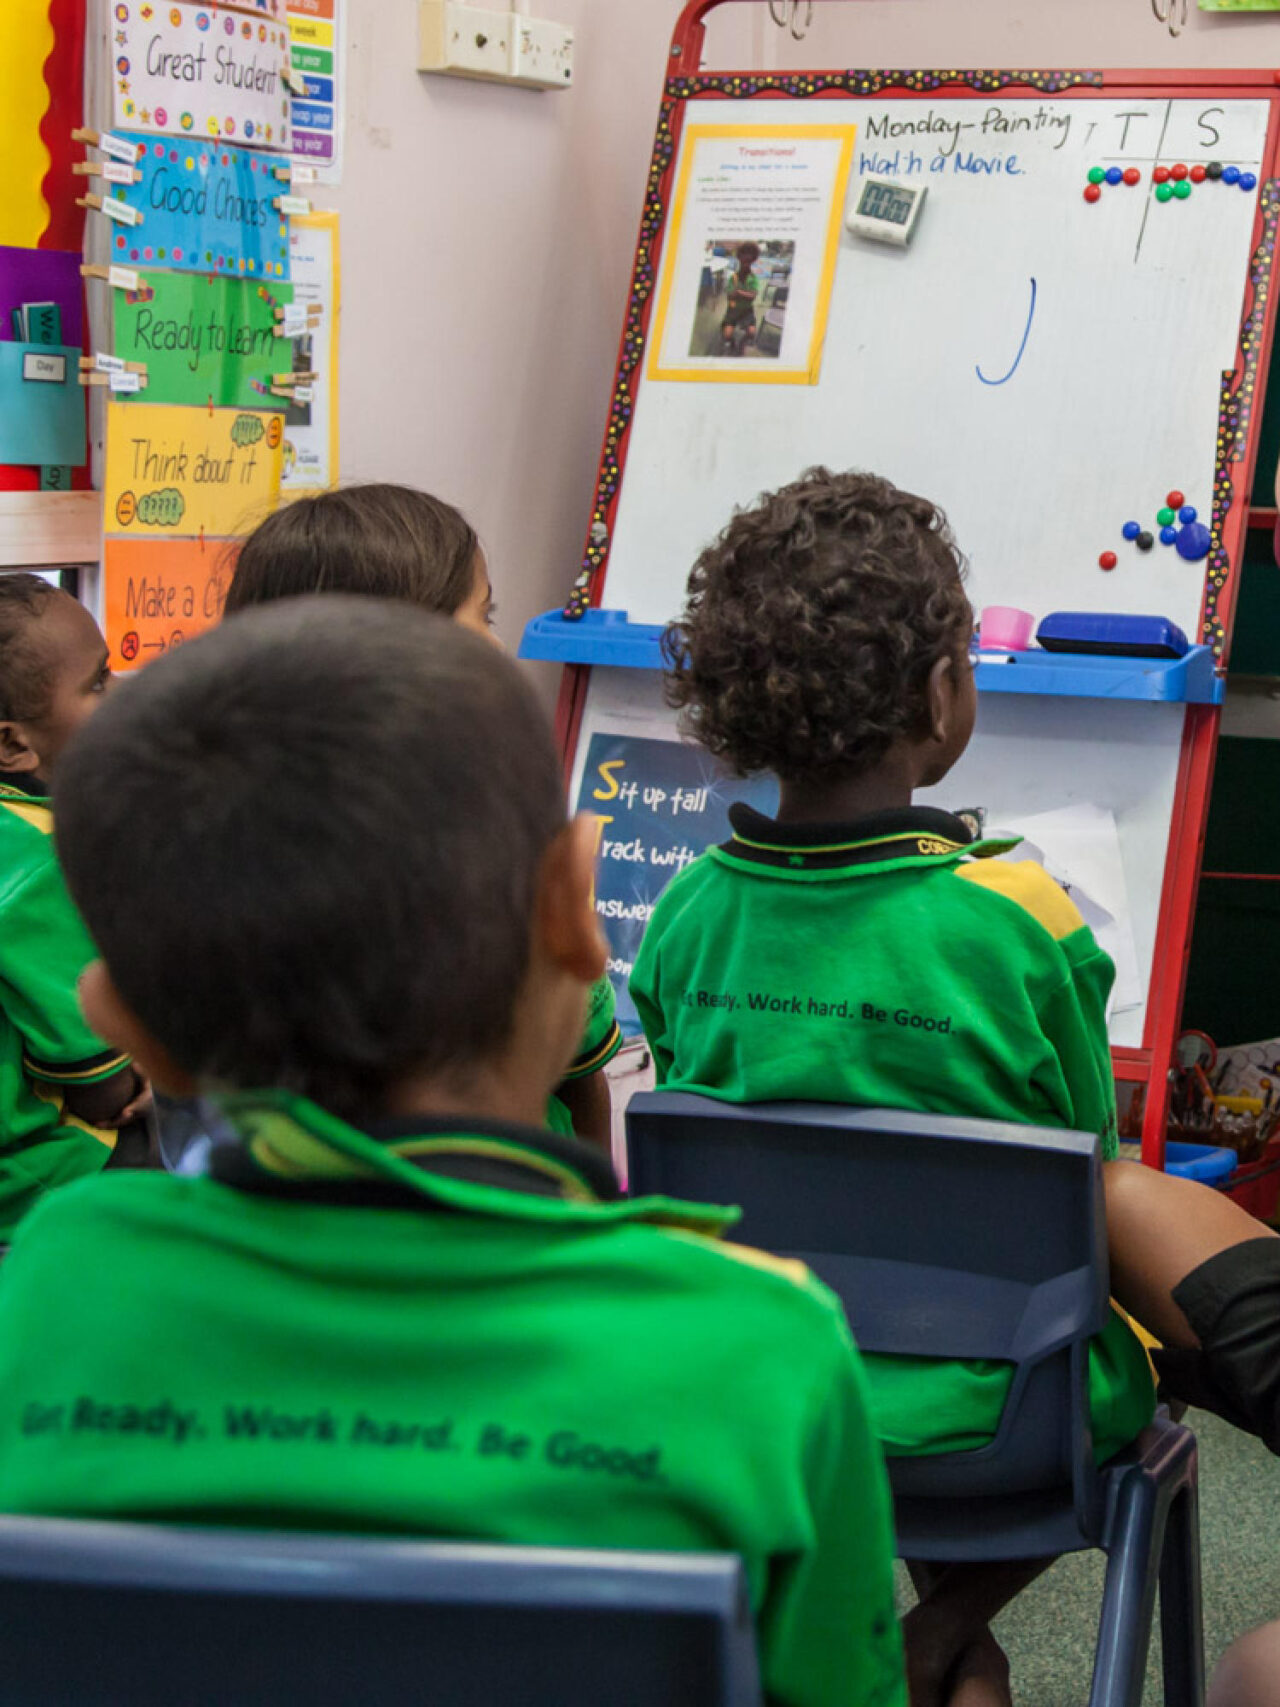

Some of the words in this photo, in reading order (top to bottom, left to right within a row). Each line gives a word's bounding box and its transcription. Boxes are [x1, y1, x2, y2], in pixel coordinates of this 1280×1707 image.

[147, 35, 206, 80] Great
[215, 46, 278, 94] Student
[1115, 112, 1149, 150] T
[1197, 108, 1225, 147] S
[930, 156, 946, 173] a
[953, 152, 1026, 175] Movie.
[150, 166, 207, 214] Good
[215, 177, 268, 227] Choices
[134, 309, 201, 371] Ready
[207, 310, 226, 351] to
[36, 360, 55, 373] Day
[131, 438, 188, 482] Think
[193, 444, 235, 483] about
[240, 448, 257, 484] it
[126, 576, 177, 618] Make
[183, 585, 194, 618] a
[593, 760, 638, 810] Sit
[643, 787, 667, 812] up
[670, 788, 708, 815] tall
[747, 993, 801, 1014] Work
[807, 997, 854, 1018] hard.
[861, 1003, 886, 1022] Be
[894, 1008, 956, 1035] Good.
[71, 1396, 207, 1446] Ready.
[223, 1403, 338, 1444] Work
[351, 1410, 461, 1453] hard.
[476, 1422, 531, 1461] Be
[544, 1430, 669, 1485] Good.
